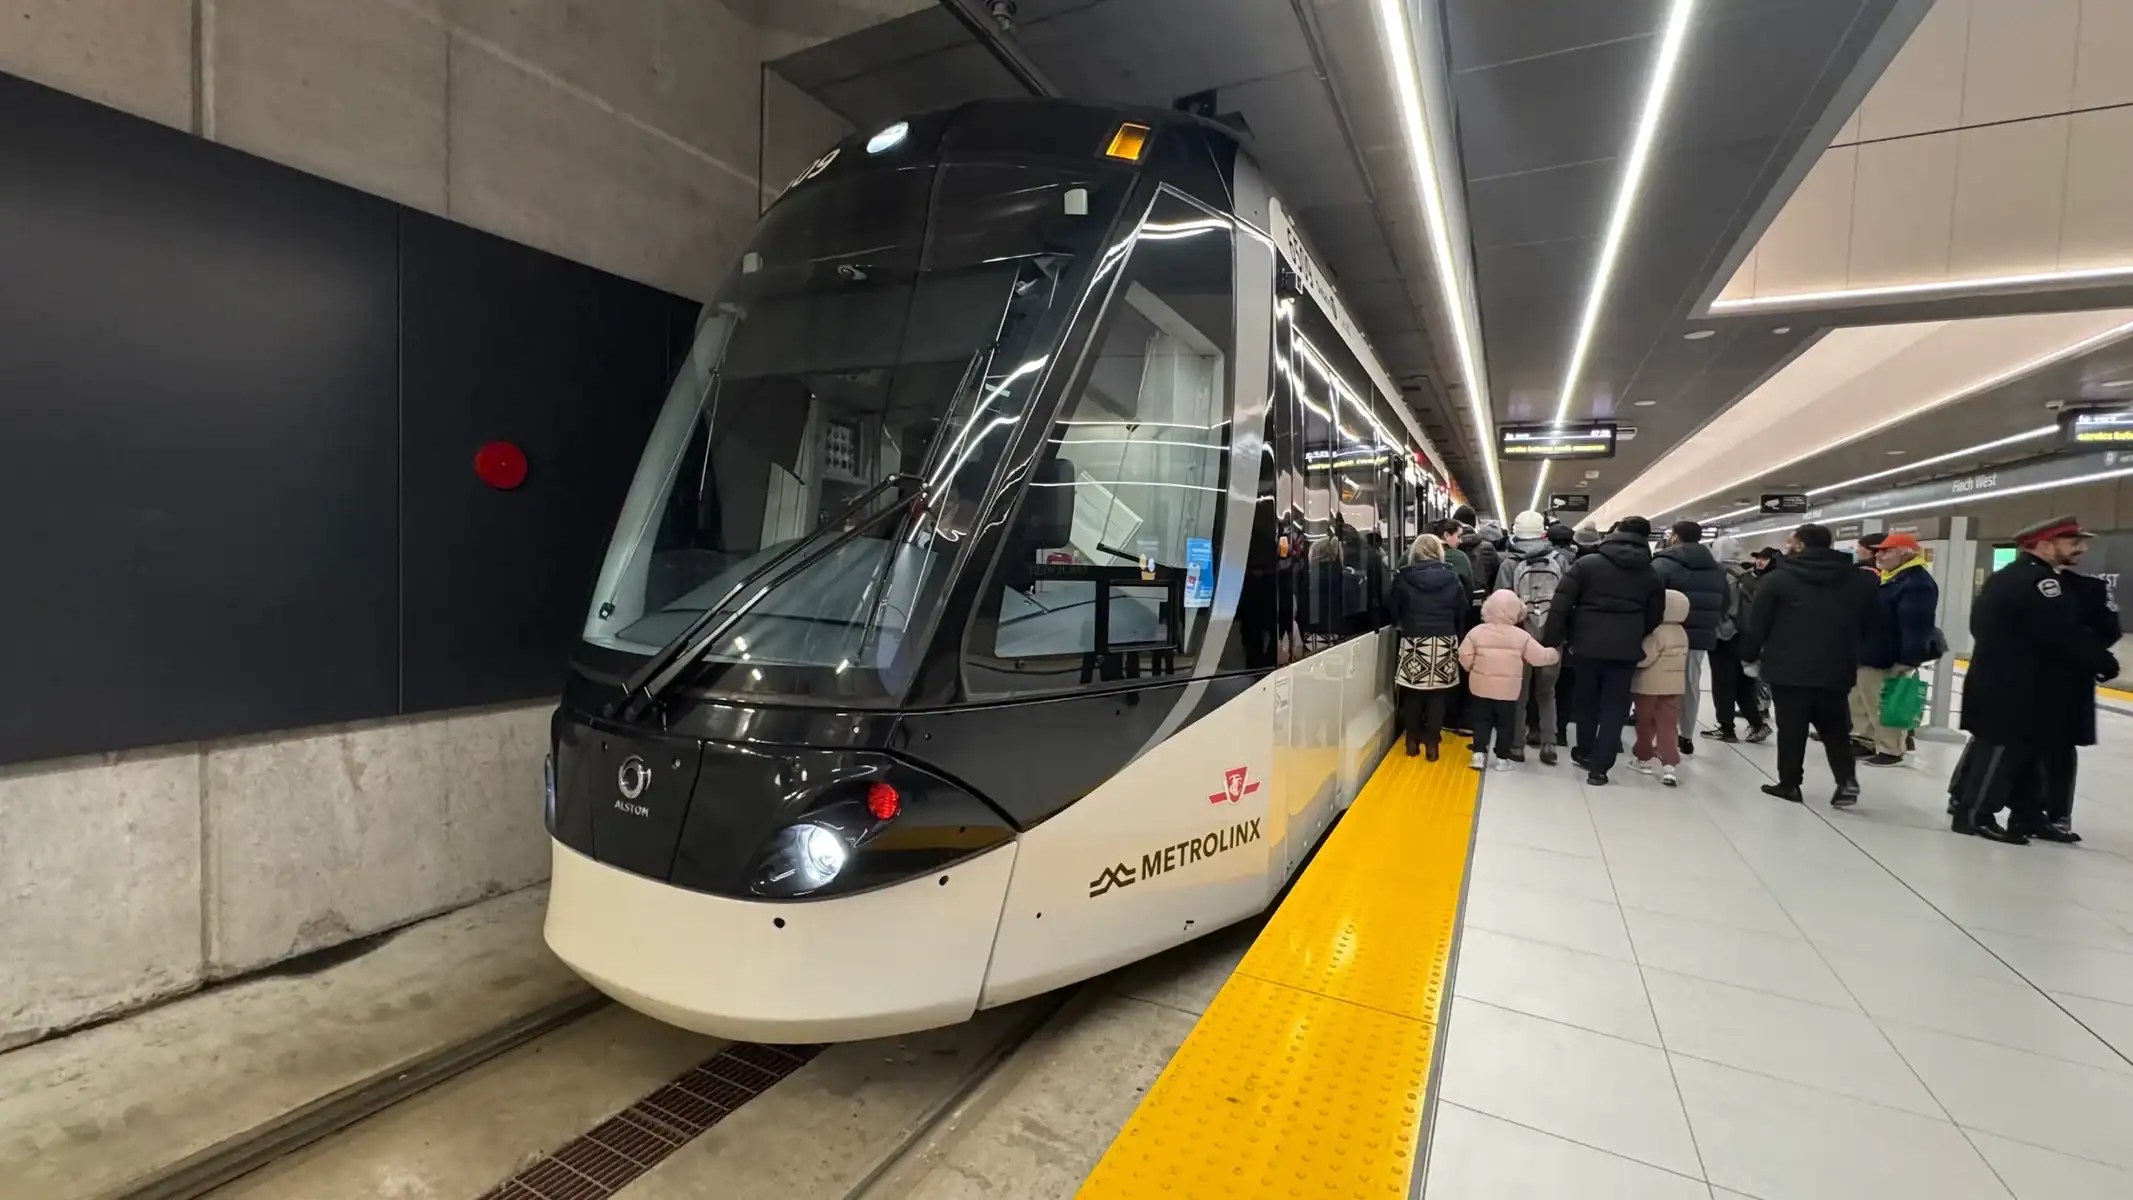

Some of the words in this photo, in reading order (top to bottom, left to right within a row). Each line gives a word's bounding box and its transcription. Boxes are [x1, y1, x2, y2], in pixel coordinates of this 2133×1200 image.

[1952, 477, 1974, 493] Finch
[1975, 472, 1997, 489] West
[614, 800, 649, 818] ALSTOM
[1141, 816, 1261, 881] METROLINX
